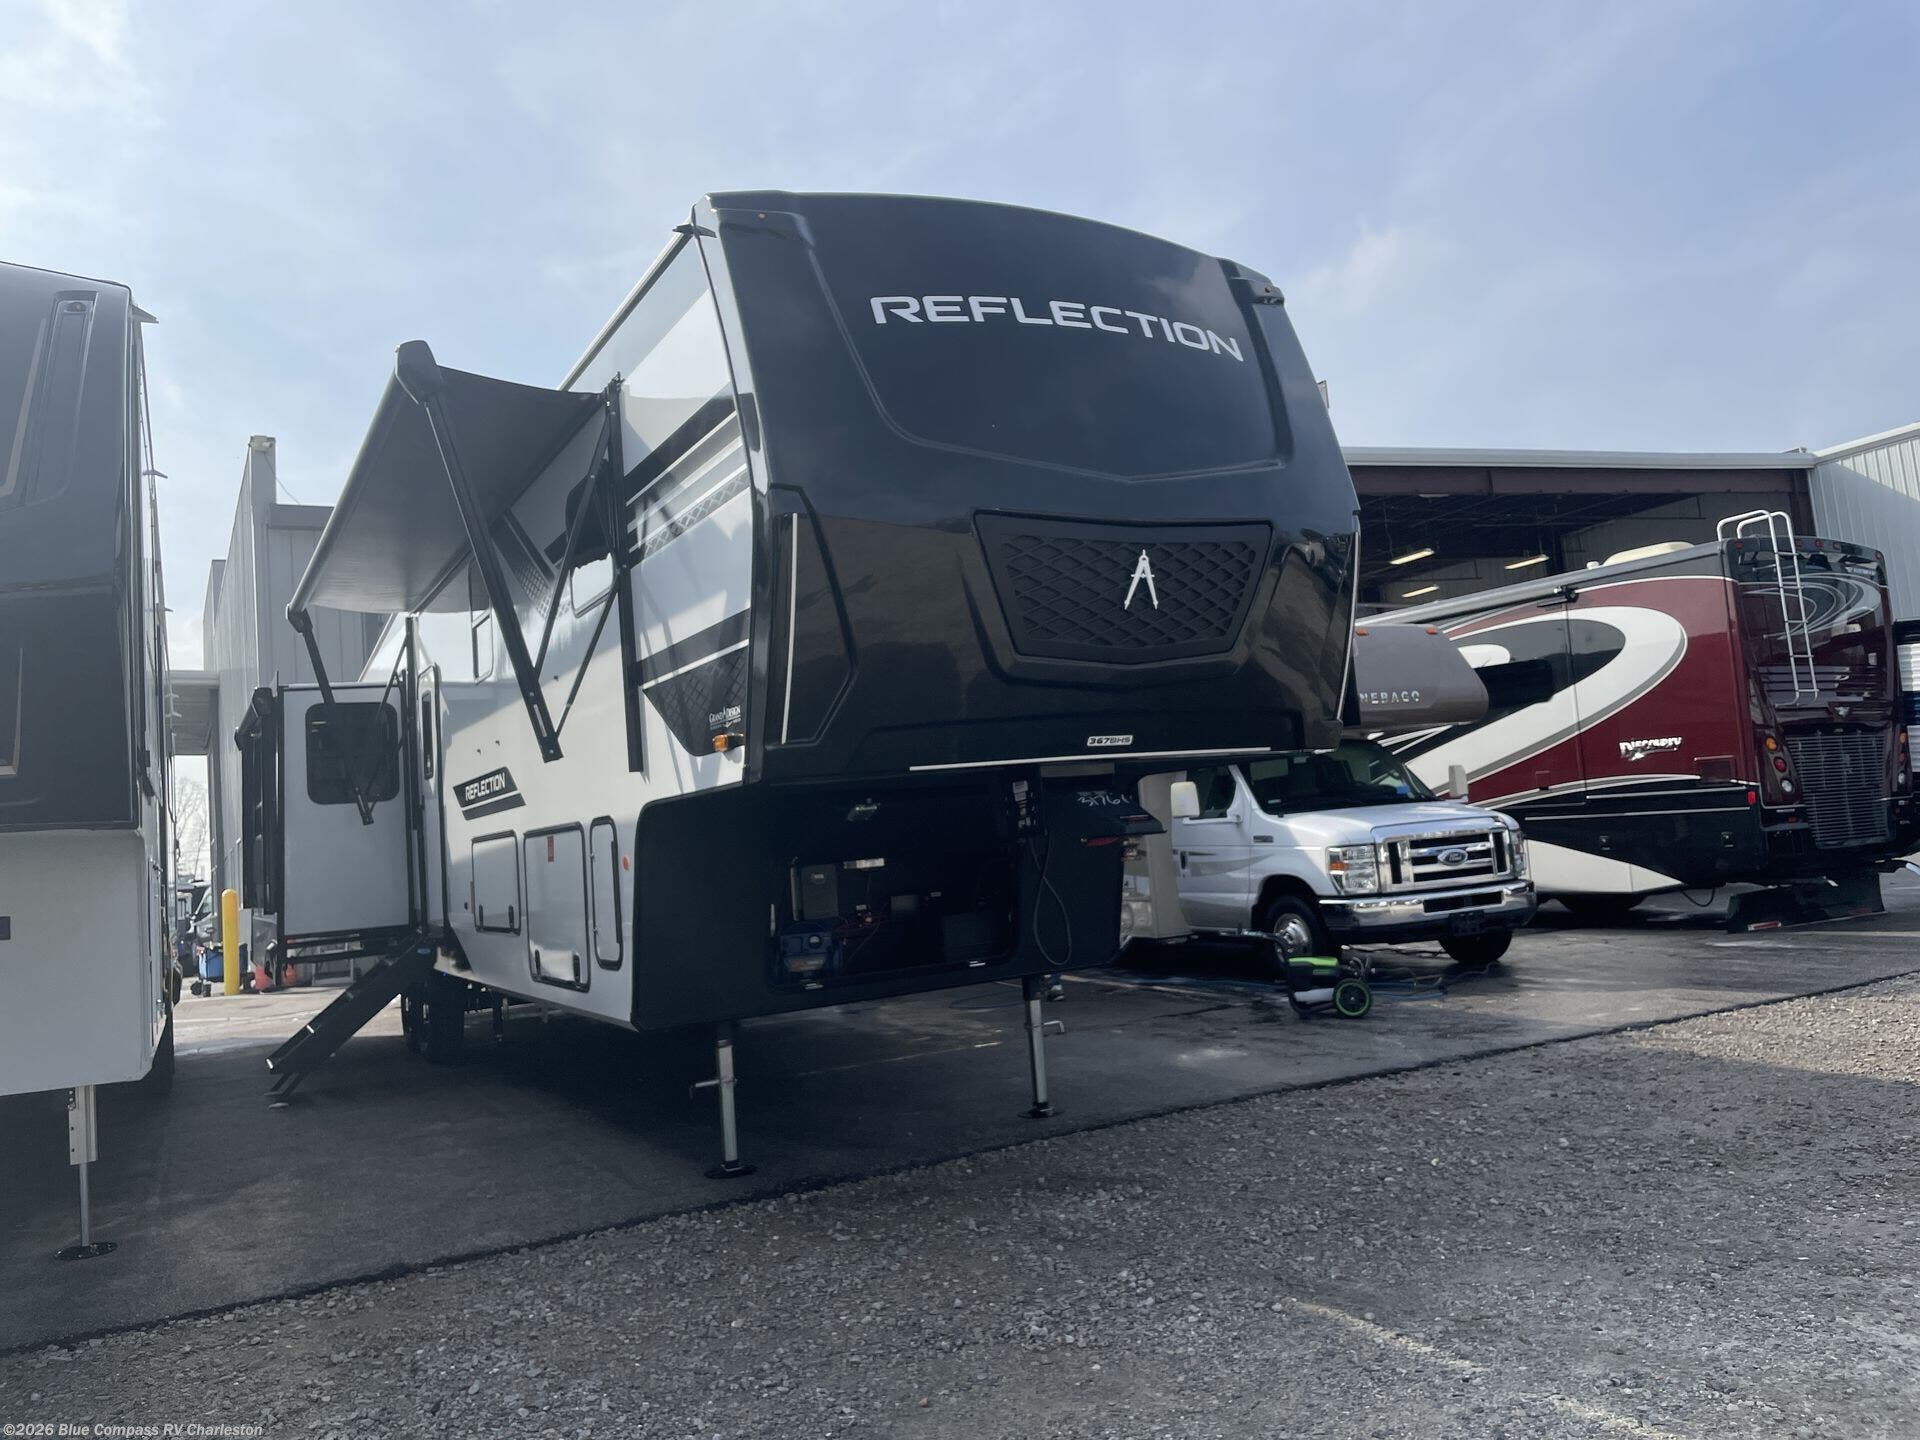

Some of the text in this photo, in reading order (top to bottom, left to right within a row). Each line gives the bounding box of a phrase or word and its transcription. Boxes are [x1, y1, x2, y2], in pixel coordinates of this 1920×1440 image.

[870, 295, 1244, 361] REFLECTION
[1359, 690, 1420, 705] NEBAGO
[465, 772, 506, 801] REFLECTION
